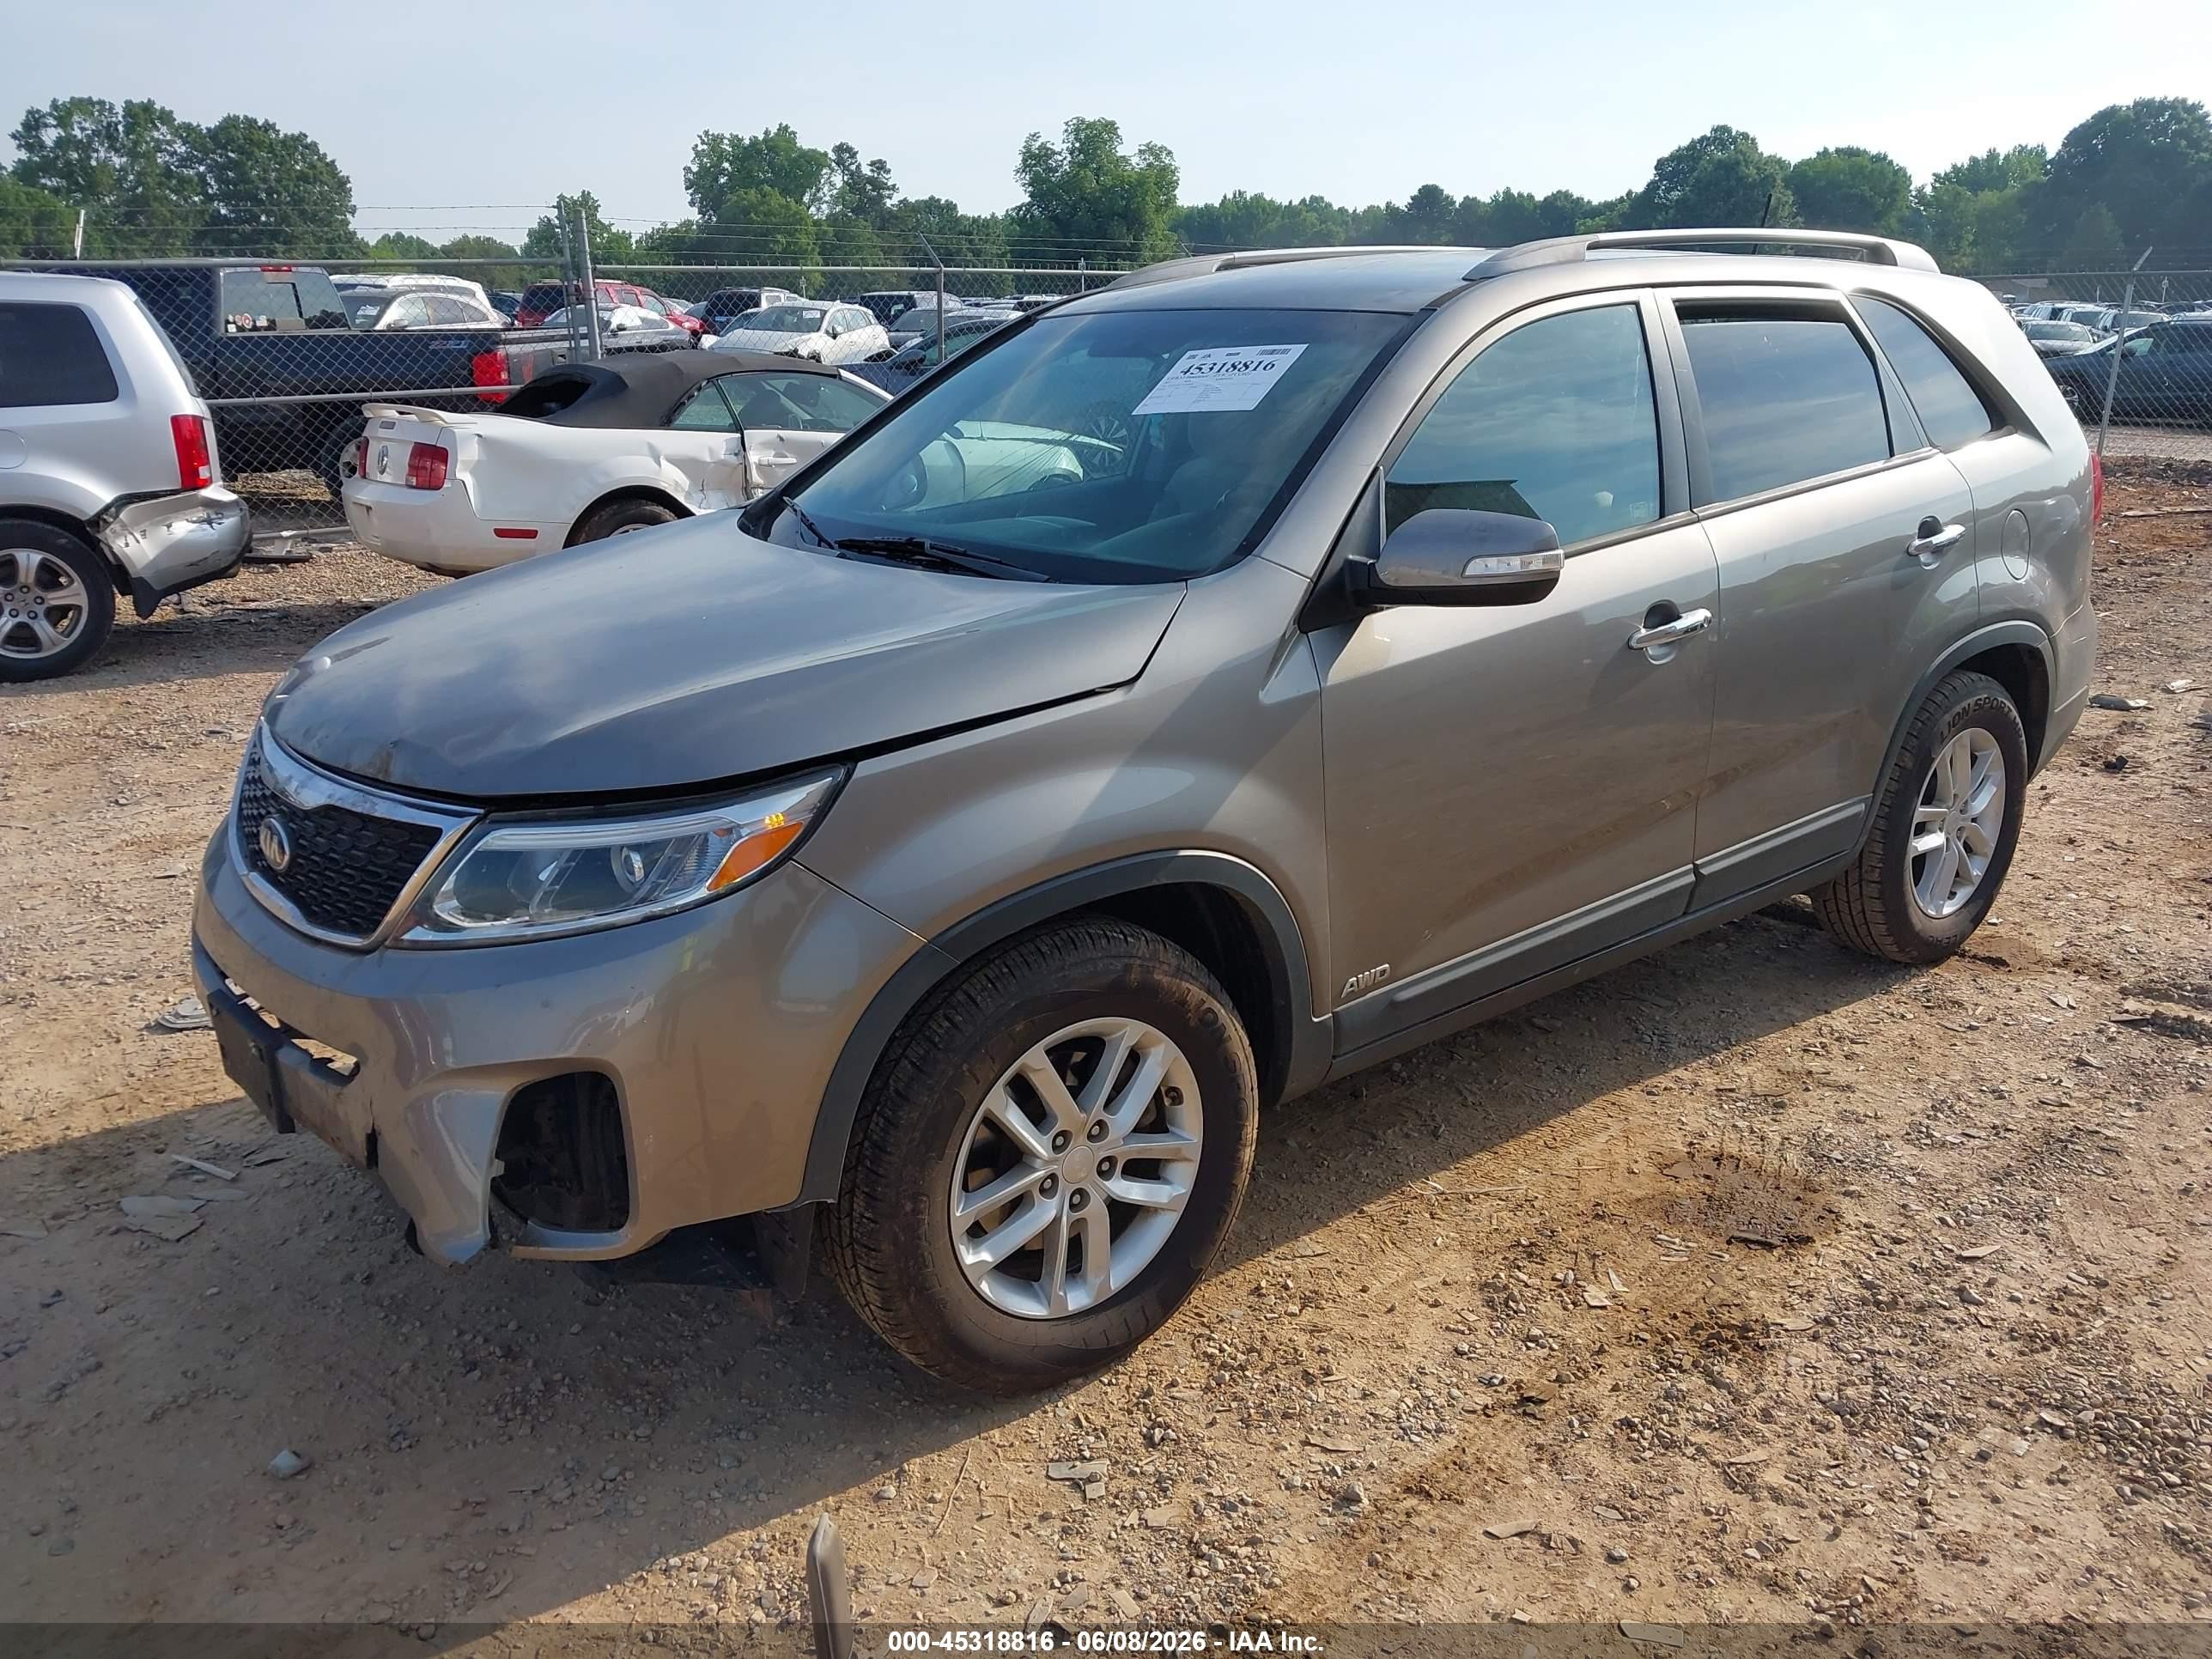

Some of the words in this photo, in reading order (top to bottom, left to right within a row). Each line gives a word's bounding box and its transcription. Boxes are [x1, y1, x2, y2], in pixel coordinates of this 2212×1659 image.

[1180, 358, 1279, 376] 45318816
[1939, 702, 1971, 744] LION
[1973, 696, 2012, 715] SPORT
[1340, 963, 1390, 999] AWD
